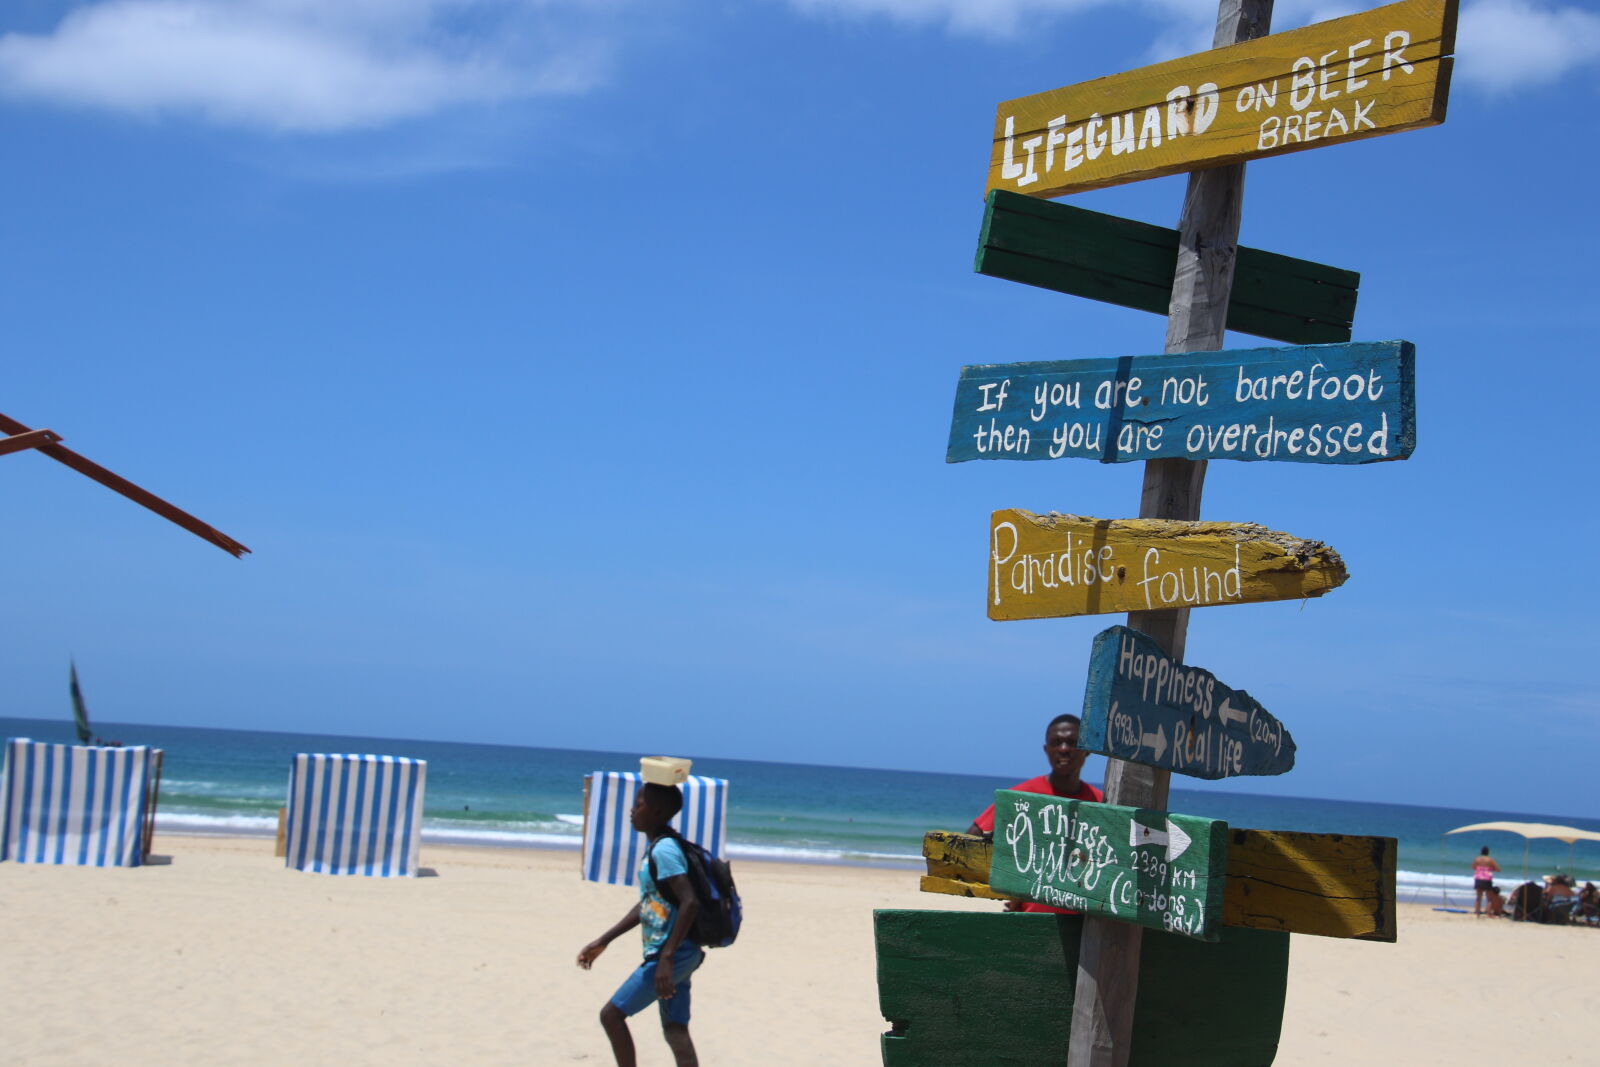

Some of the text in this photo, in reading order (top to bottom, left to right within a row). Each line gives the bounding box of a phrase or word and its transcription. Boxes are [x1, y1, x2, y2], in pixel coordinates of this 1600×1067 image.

[1001, 30, 1414, 187] LIFEGUARD ON BEER
[1257, 100, 1376, 150] BREAK
[977, 363, 1384, 422] If you are not barefoot
[974, 412, 1388, 458] then you are overdressed
[993, 522, 1242, 610] Paradise found
[1119, 634, 1282, 756] Happiness (20m)
[1172, 720, 1212, 771] Real
[1218, 732, 1242, 778] life
[1006, 812, 1101, 899] Oyster
[1038, 804, 1118, 868] Thirsty
[1042, 886, 1087, 911] Tavern
[1131, 851, 1196, 889] 2389 KM
